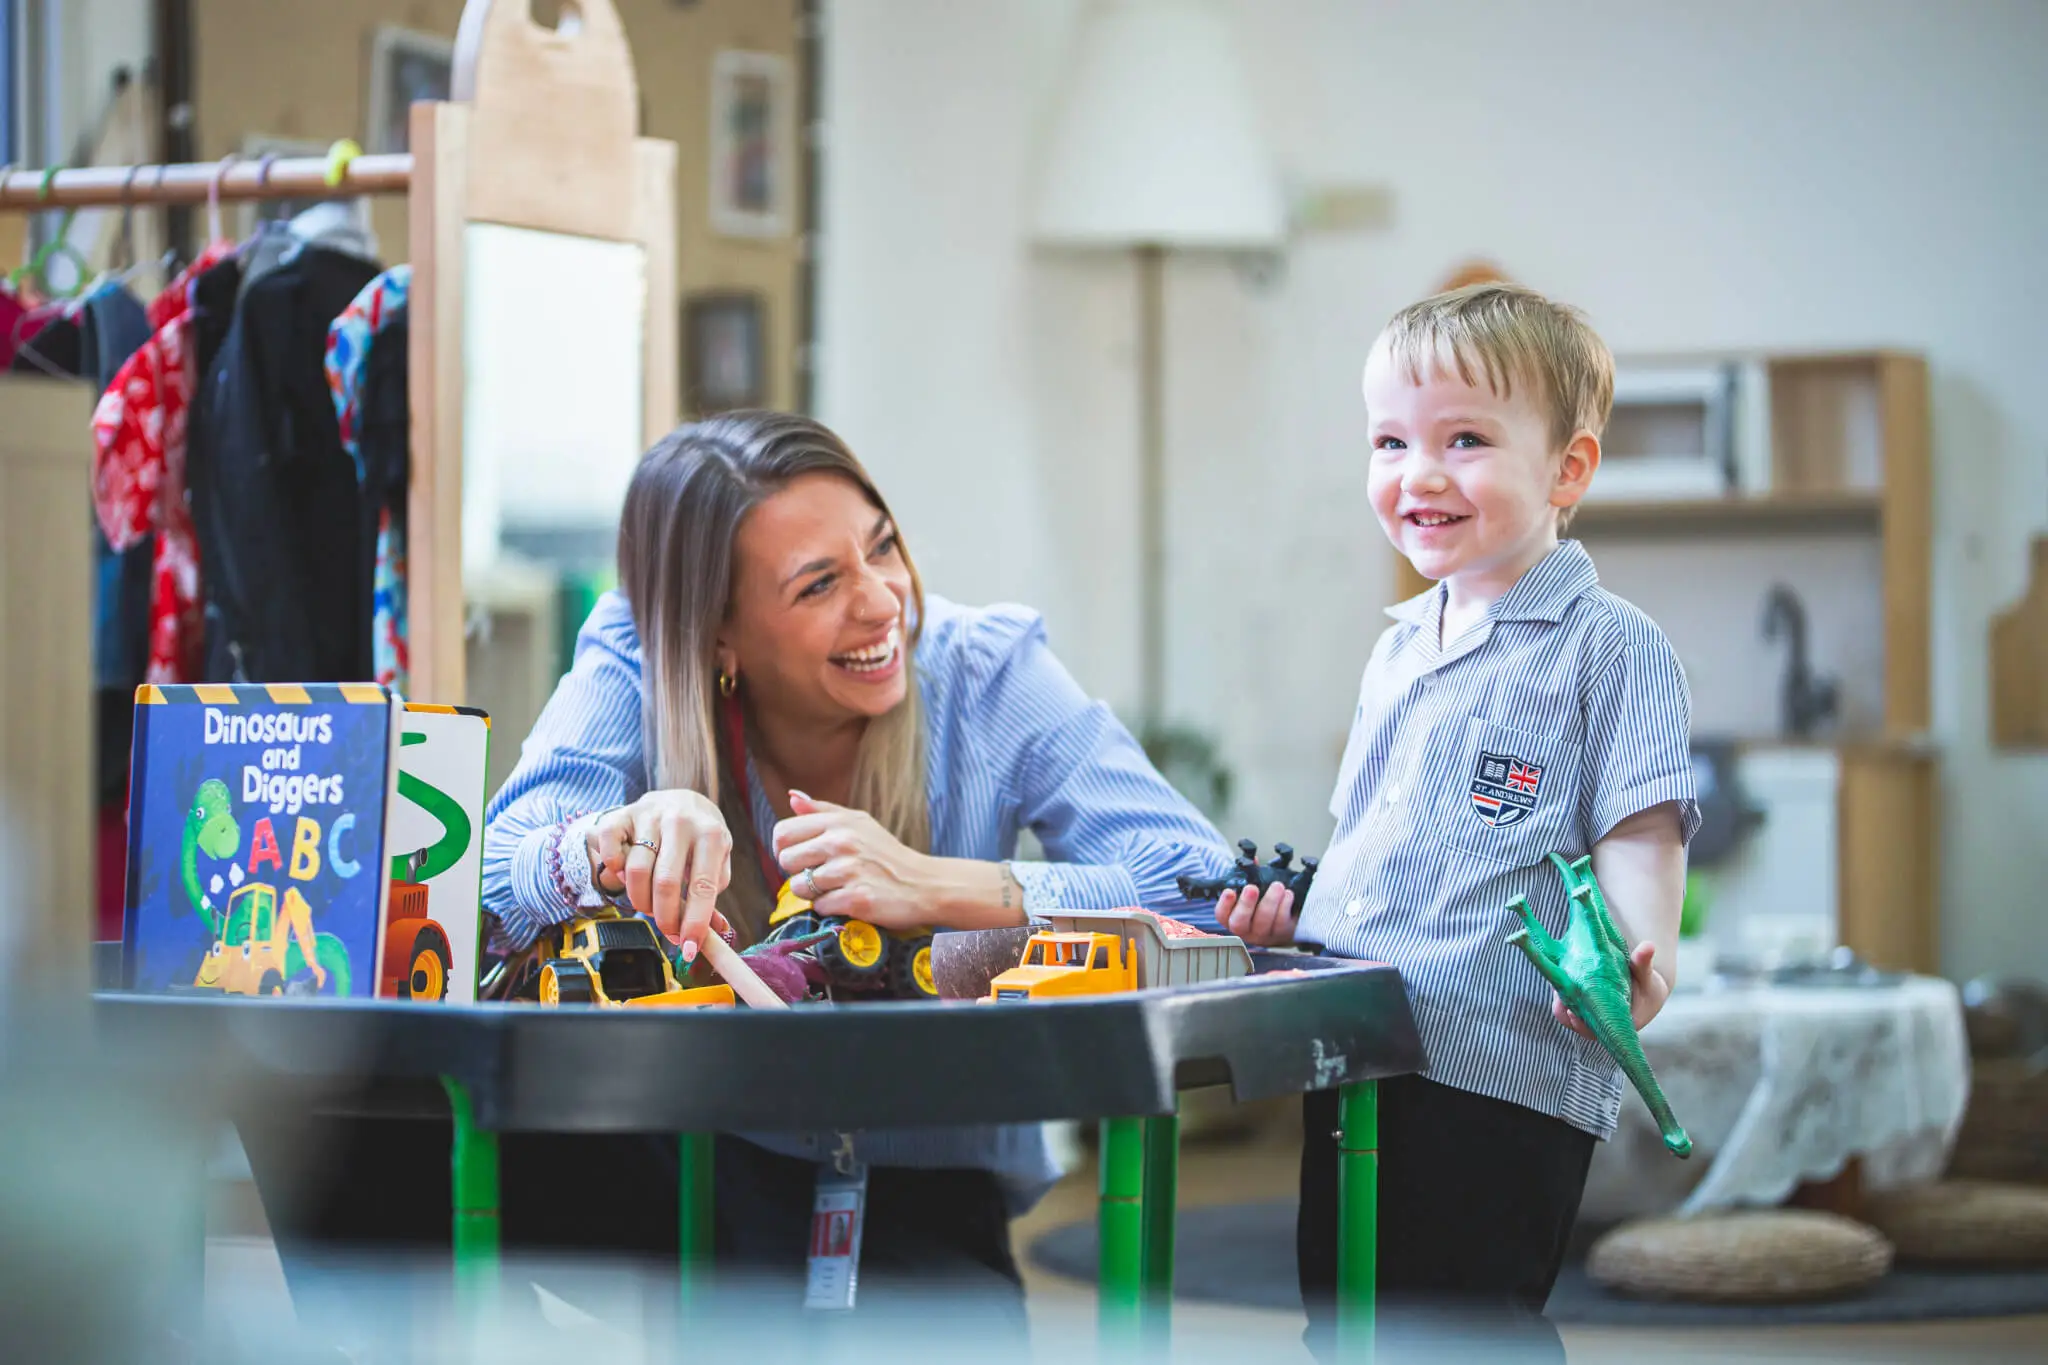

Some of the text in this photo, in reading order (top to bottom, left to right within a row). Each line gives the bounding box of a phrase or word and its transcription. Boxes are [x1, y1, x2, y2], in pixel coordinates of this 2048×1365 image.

[204, 707, 333, 744] Dinosaurs
[262, 744, 301, 771] and
[243, 765, 344, 815] Diggers
[1488, 788, 1534, 806] ANDREWS
